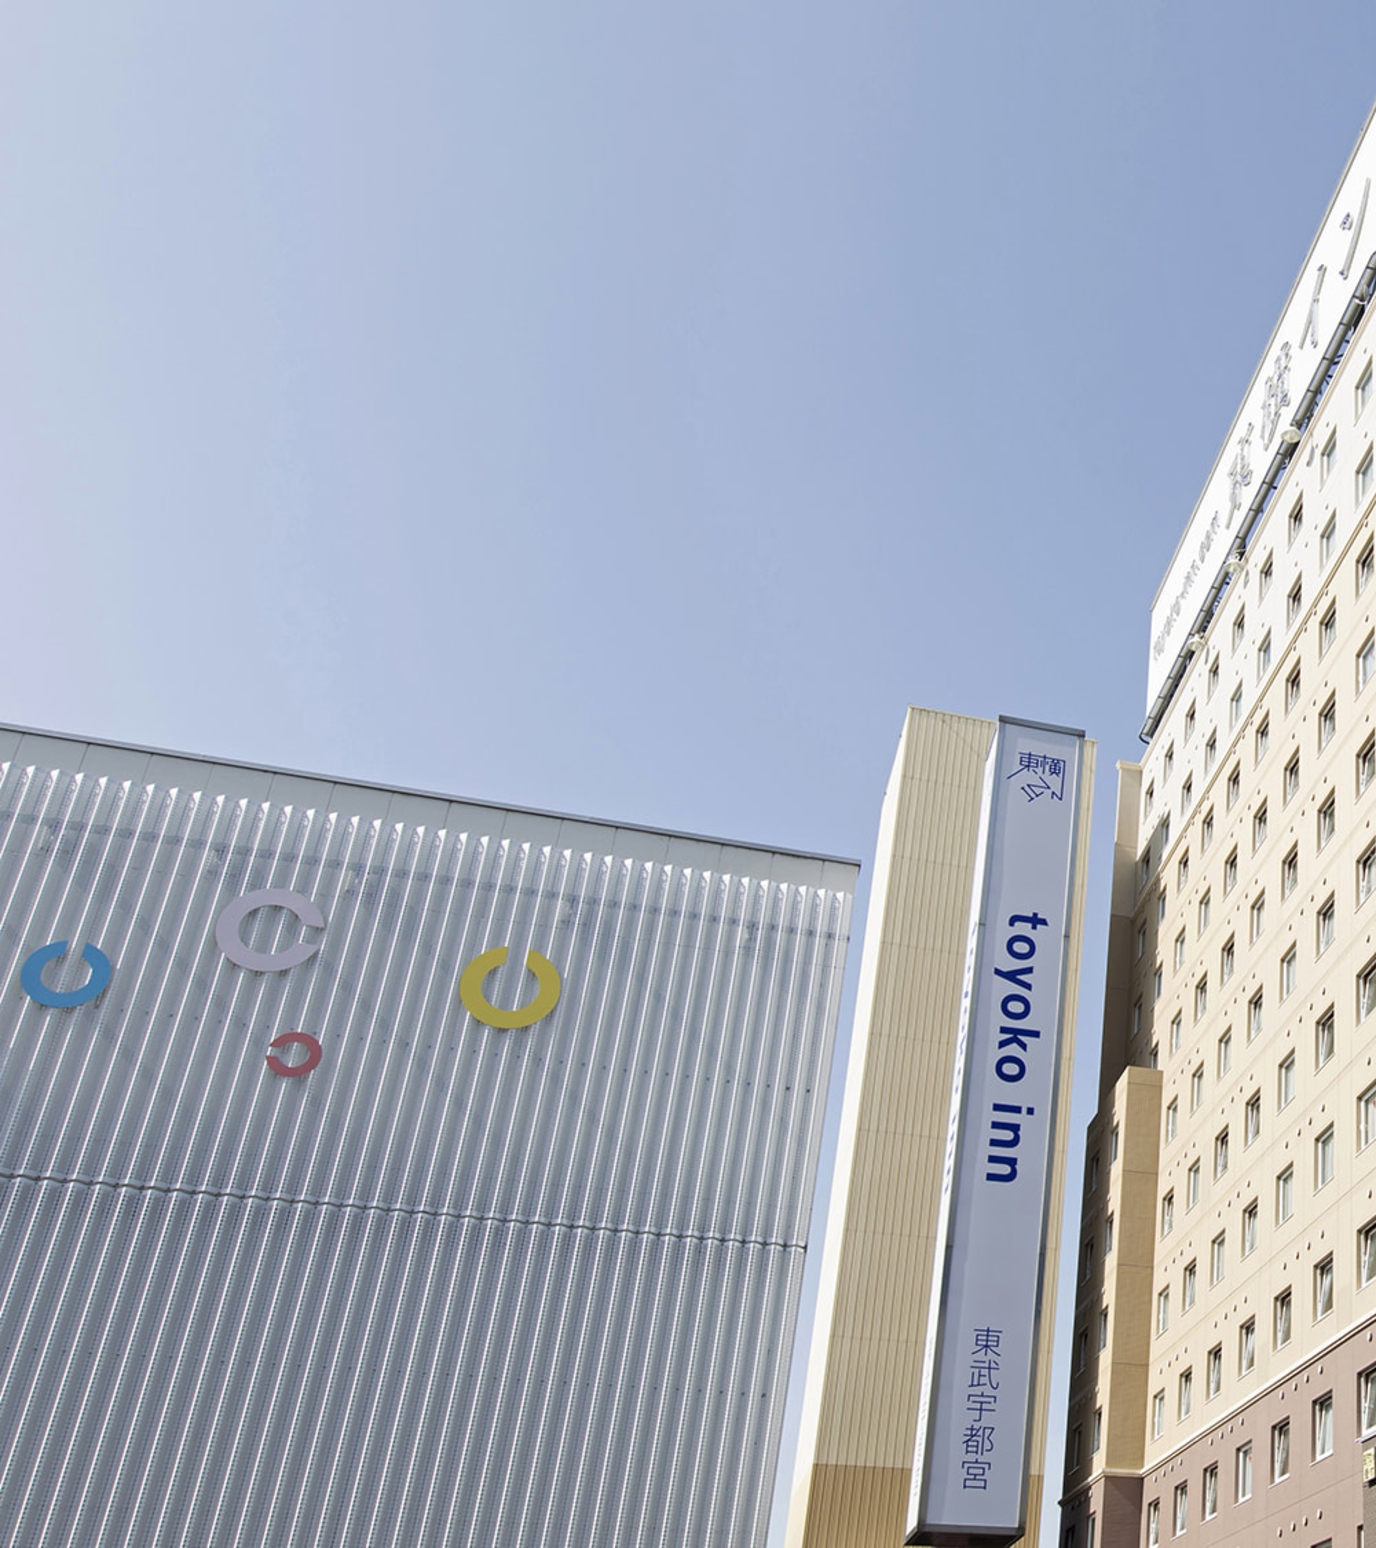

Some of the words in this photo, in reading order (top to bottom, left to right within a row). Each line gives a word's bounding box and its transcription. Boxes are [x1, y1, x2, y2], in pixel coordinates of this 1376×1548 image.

[993, 912, 1049, 1084] toyoko
[985, 1102, 1035, 1184] inn
[961, 1326, 1003, 1491] 東武宇都宮
